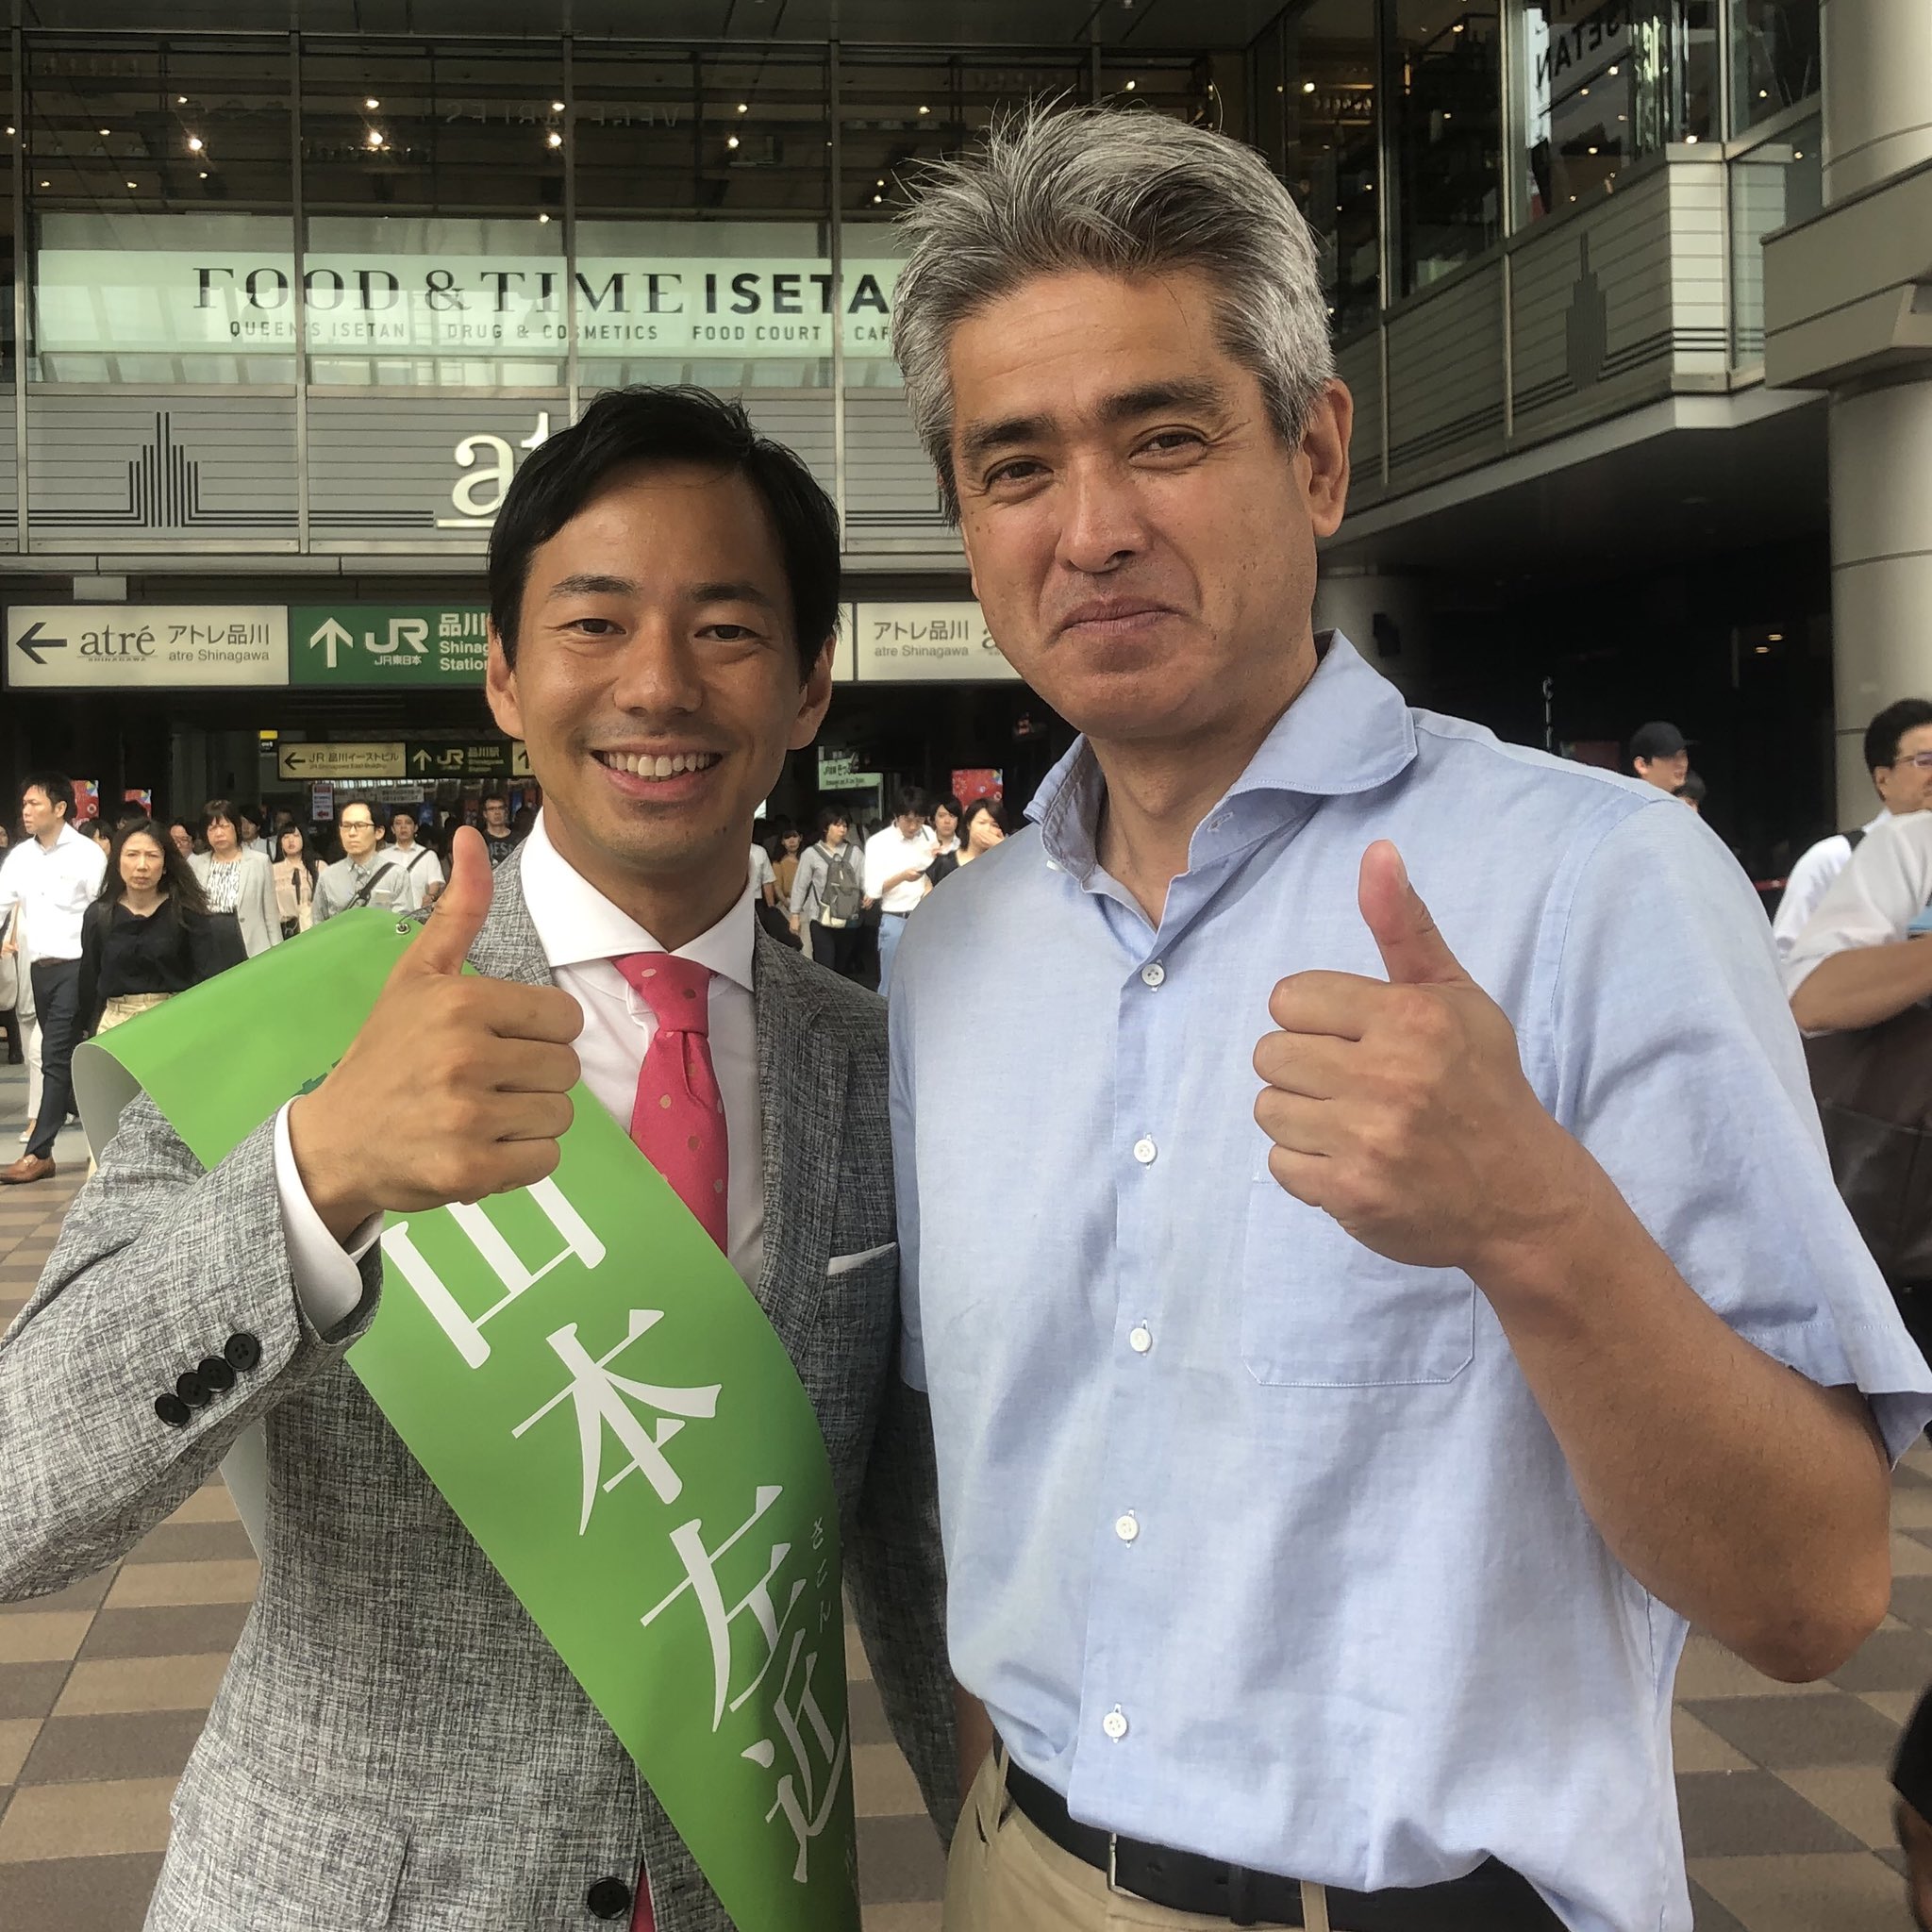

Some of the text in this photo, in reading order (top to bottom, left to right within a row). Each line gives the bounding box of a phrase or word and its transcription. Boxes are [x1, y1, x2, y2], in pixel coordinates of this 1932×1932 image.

[192, 268, 891, 315] FOOD & TIME ISETA
[333, 322, 405, 338] ISETAN
[448, 324, 502, 339] DRUG
[518, 325, 529, 339] &
[692, 325, 745, 341] FOOD
[756, 325, 822, 341] COURT
[168, 624, 270, 645] アトレ品川
[365, 618, 430, 653] JR
[874, 620, 969, 641] アトレ品川
[169, 648, 270, 663] atre Shinagawa
[874, 644, 969, 658] atre Shinagawa
[381, 1177, 849, 1883] 山本左近
